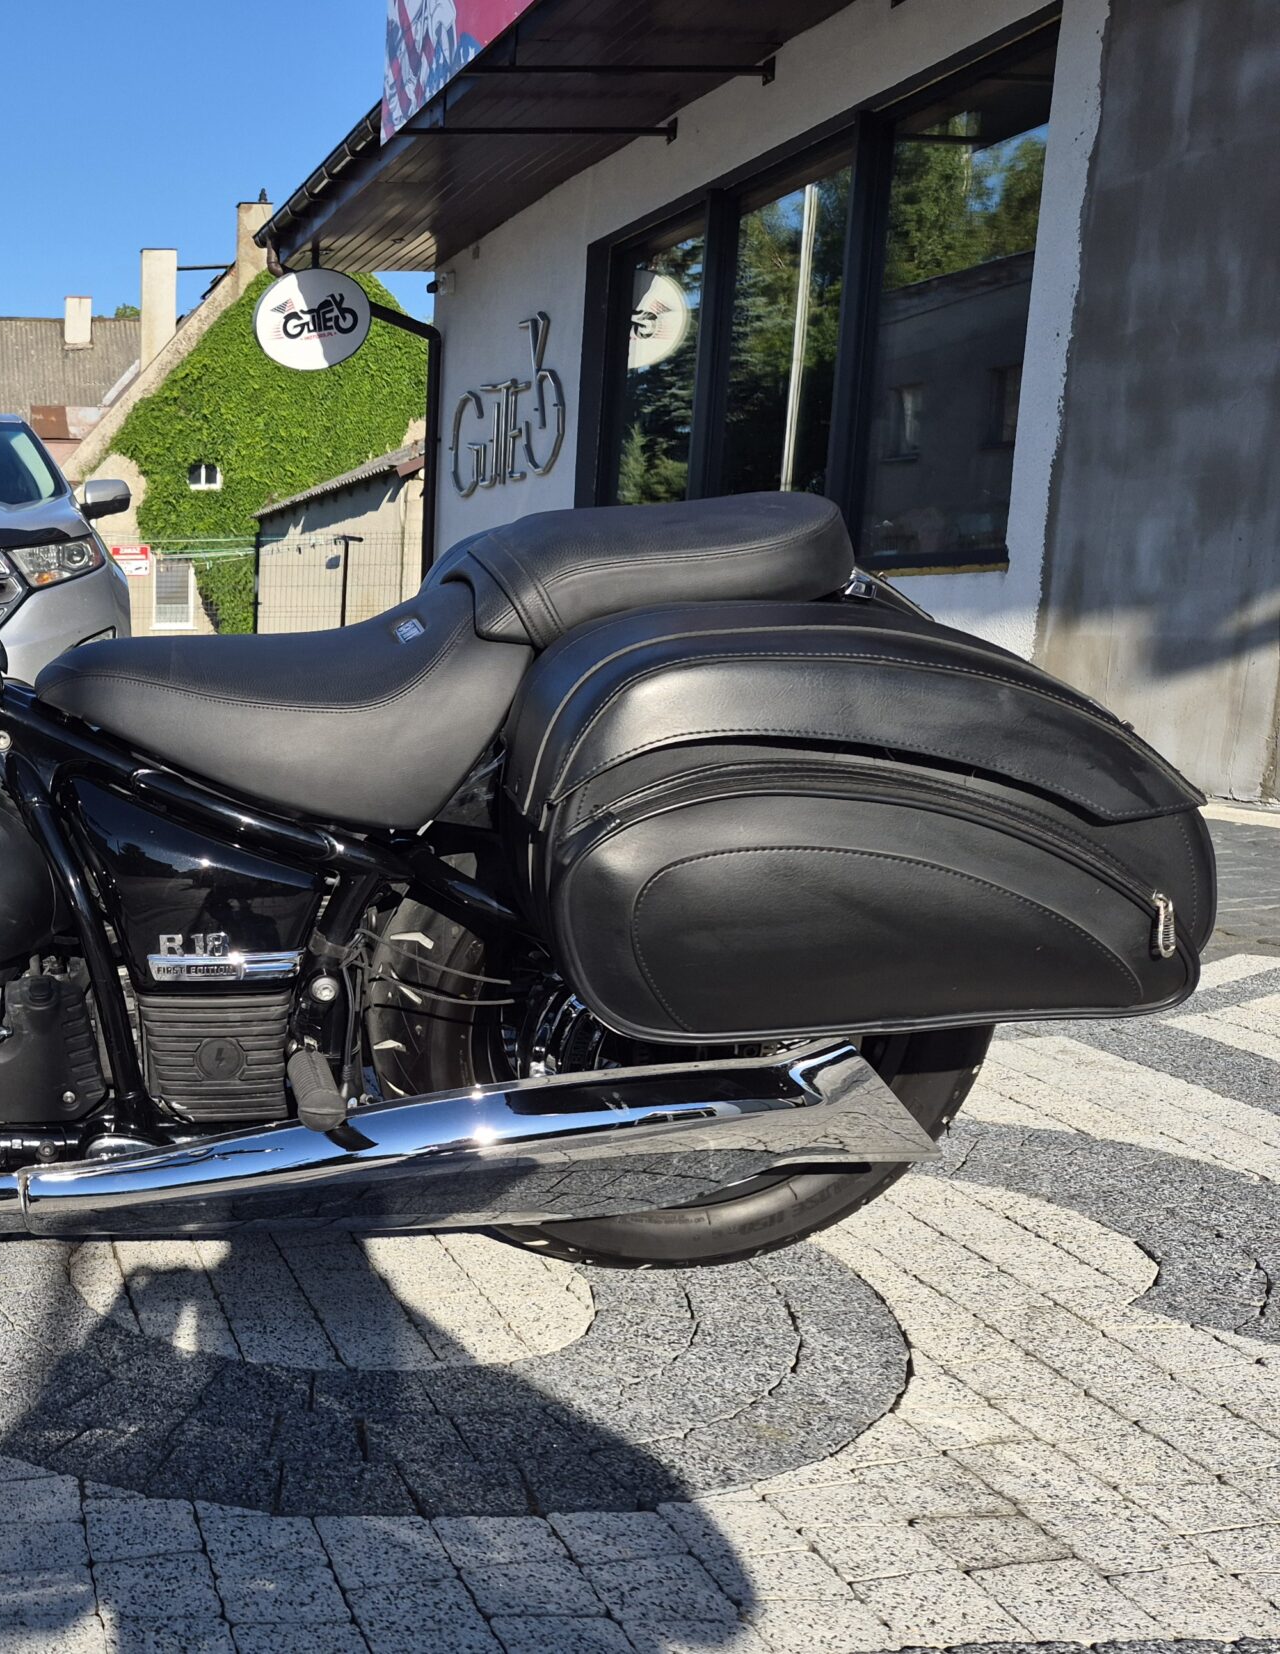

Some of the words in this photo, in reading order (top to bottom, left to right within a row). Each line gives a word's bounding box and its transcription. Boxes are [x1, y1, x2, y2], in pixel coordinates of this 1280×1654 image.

[159, 934, 185, 957] R
[190, 931, 230, 957] 18
[157, 965, 184, 976] FIRST
[189, 964, 238, 976] EDITION
